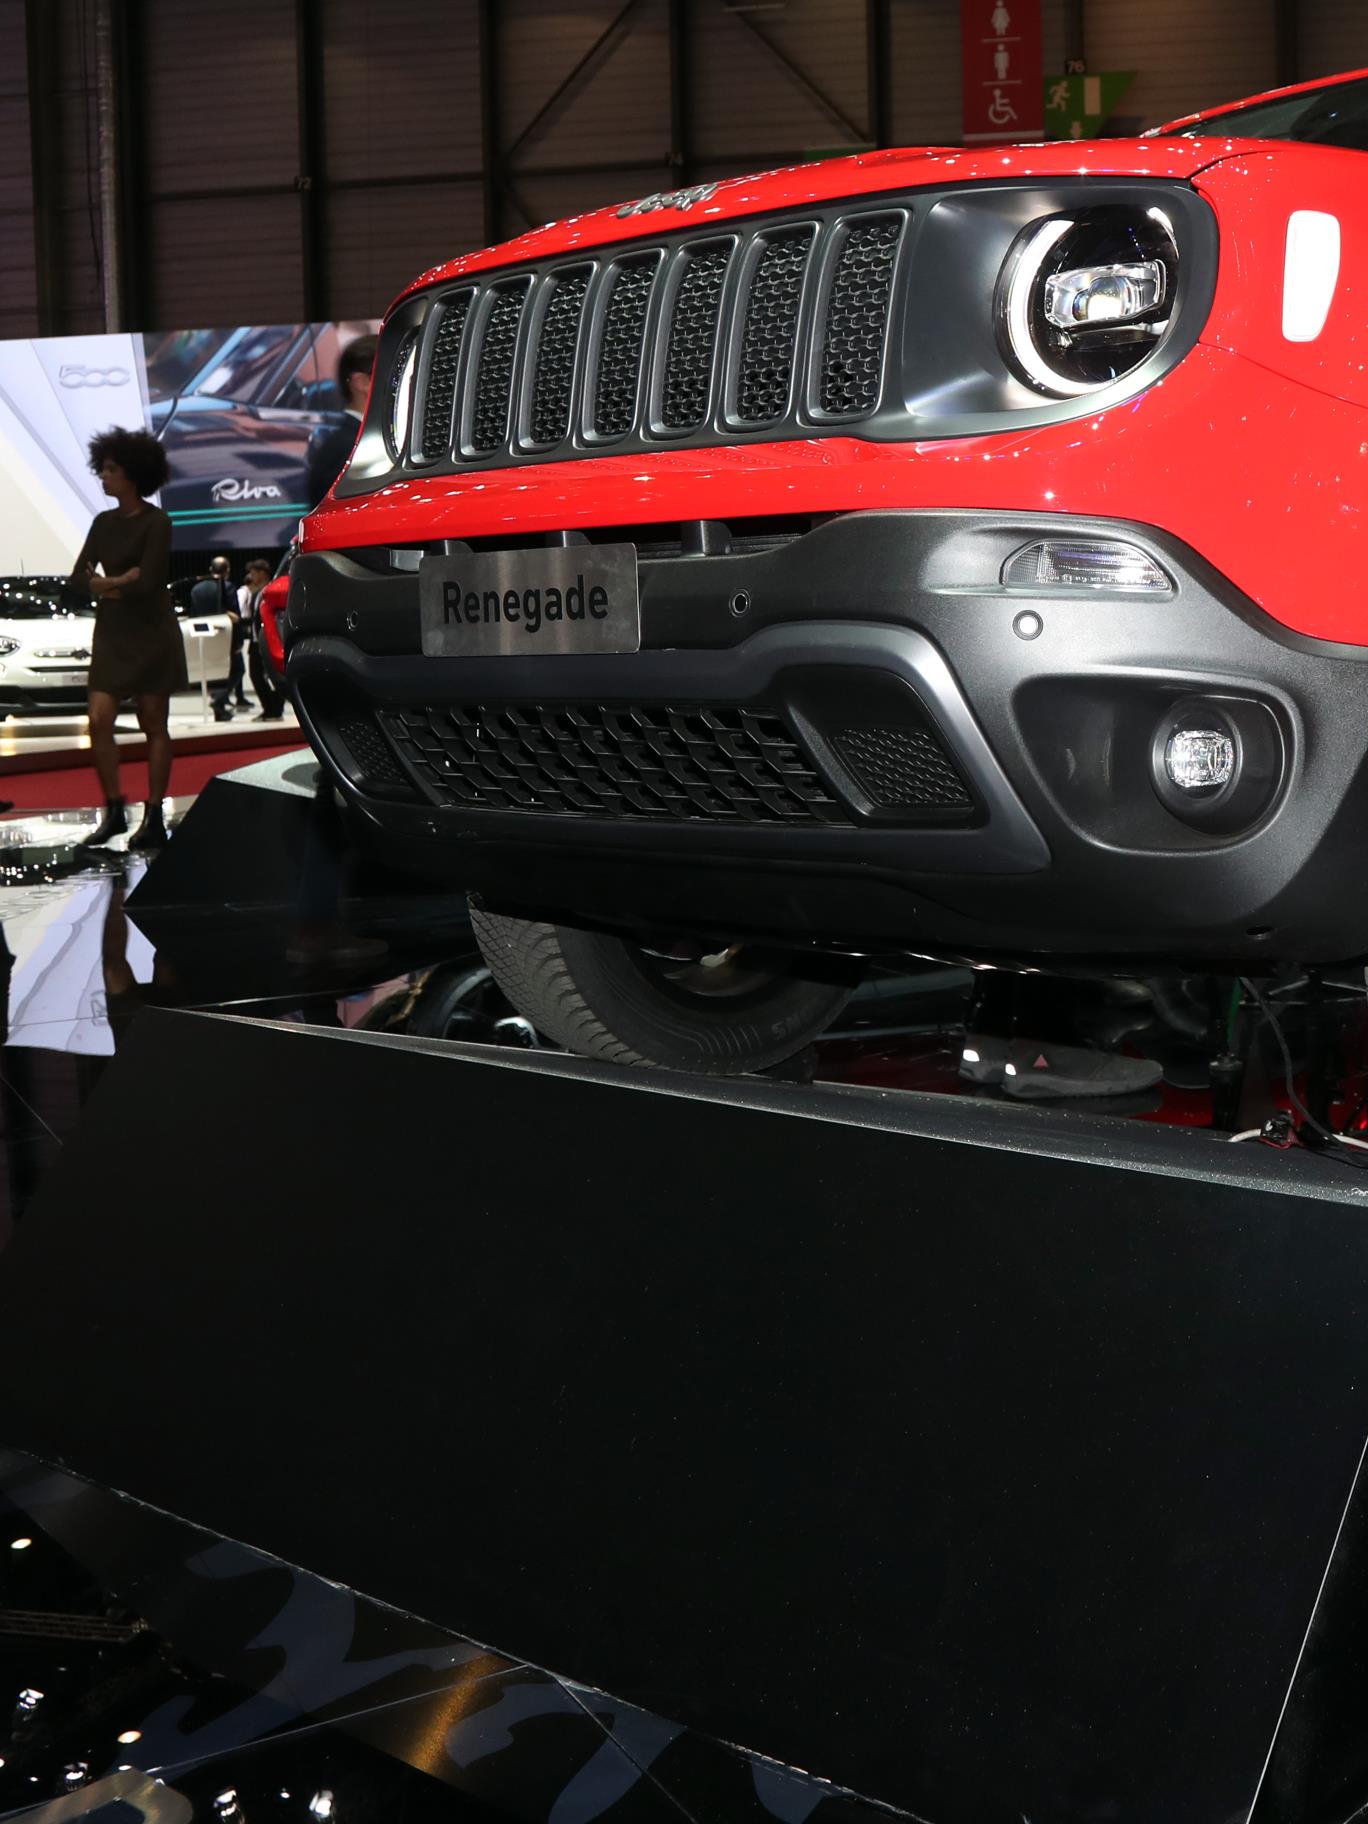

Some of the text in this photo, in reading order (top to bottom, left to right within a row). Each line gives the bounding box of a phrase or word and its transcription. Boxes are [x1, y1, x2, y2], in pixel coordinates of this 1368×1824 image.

[59, 364, 131, 389] 500
[211, 478, 282, 502] Riva
[442, 574, 609, 634] Renegade
